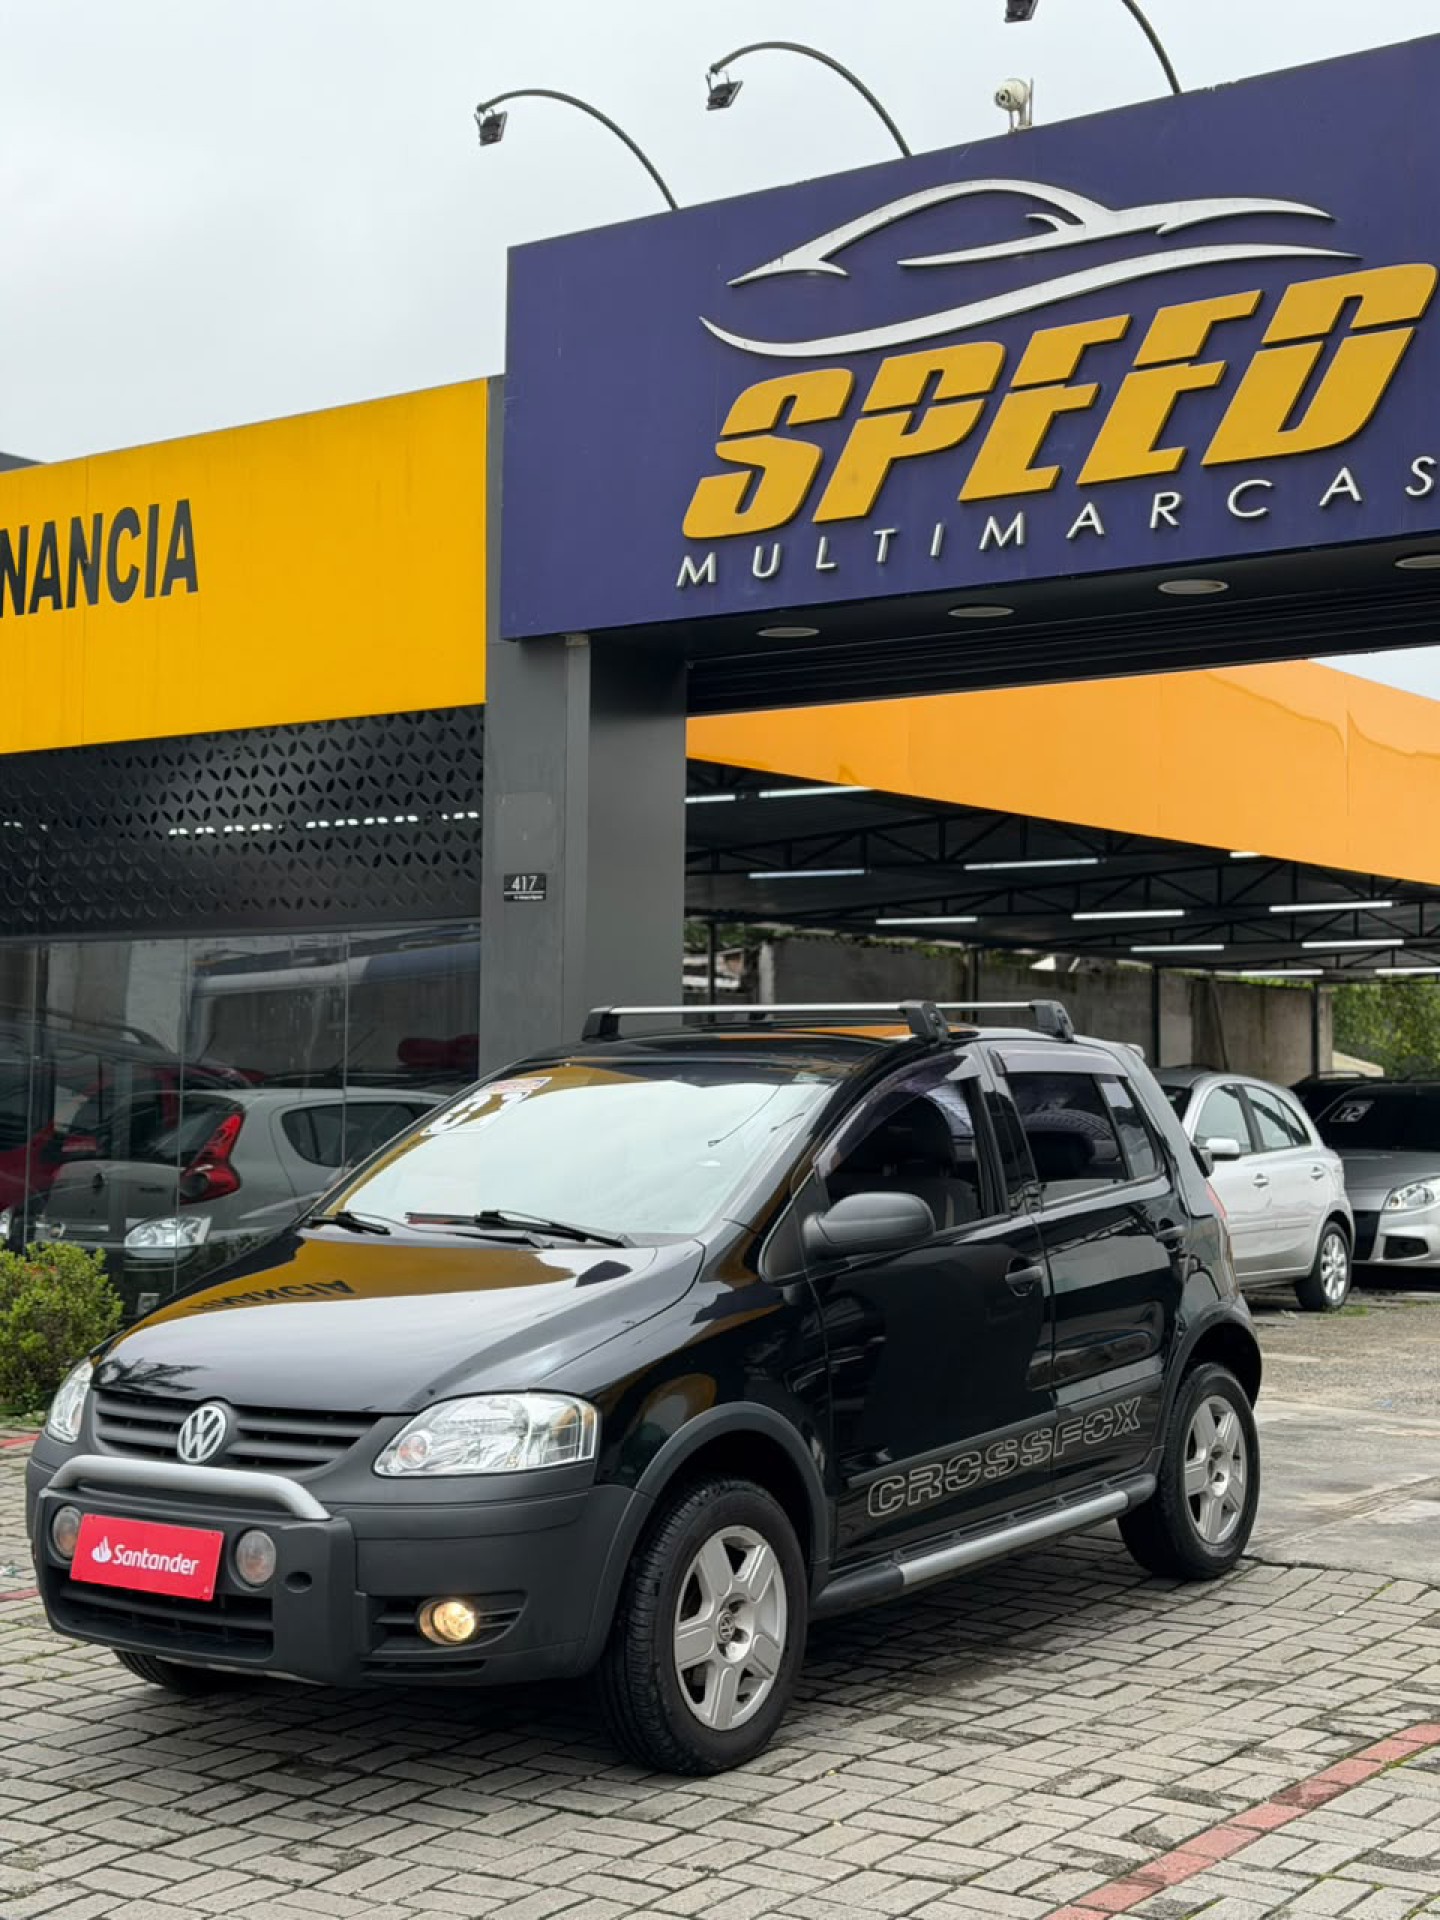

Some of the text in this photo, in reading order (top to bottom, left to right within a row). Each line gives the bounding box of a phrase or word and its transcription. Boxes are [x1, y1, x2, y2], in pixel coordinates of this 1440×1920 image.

[682, 263, 1438, 539] SPEED
[0, 498, 199, 619] NANCIA
[676, 455, 1438, 588] MULTIMARCAS
[511, 875, 538, 891] 417
[867, 1396, 1142, 1518] CROSSFOX
[112, 1544, 199, 1576] Santander
